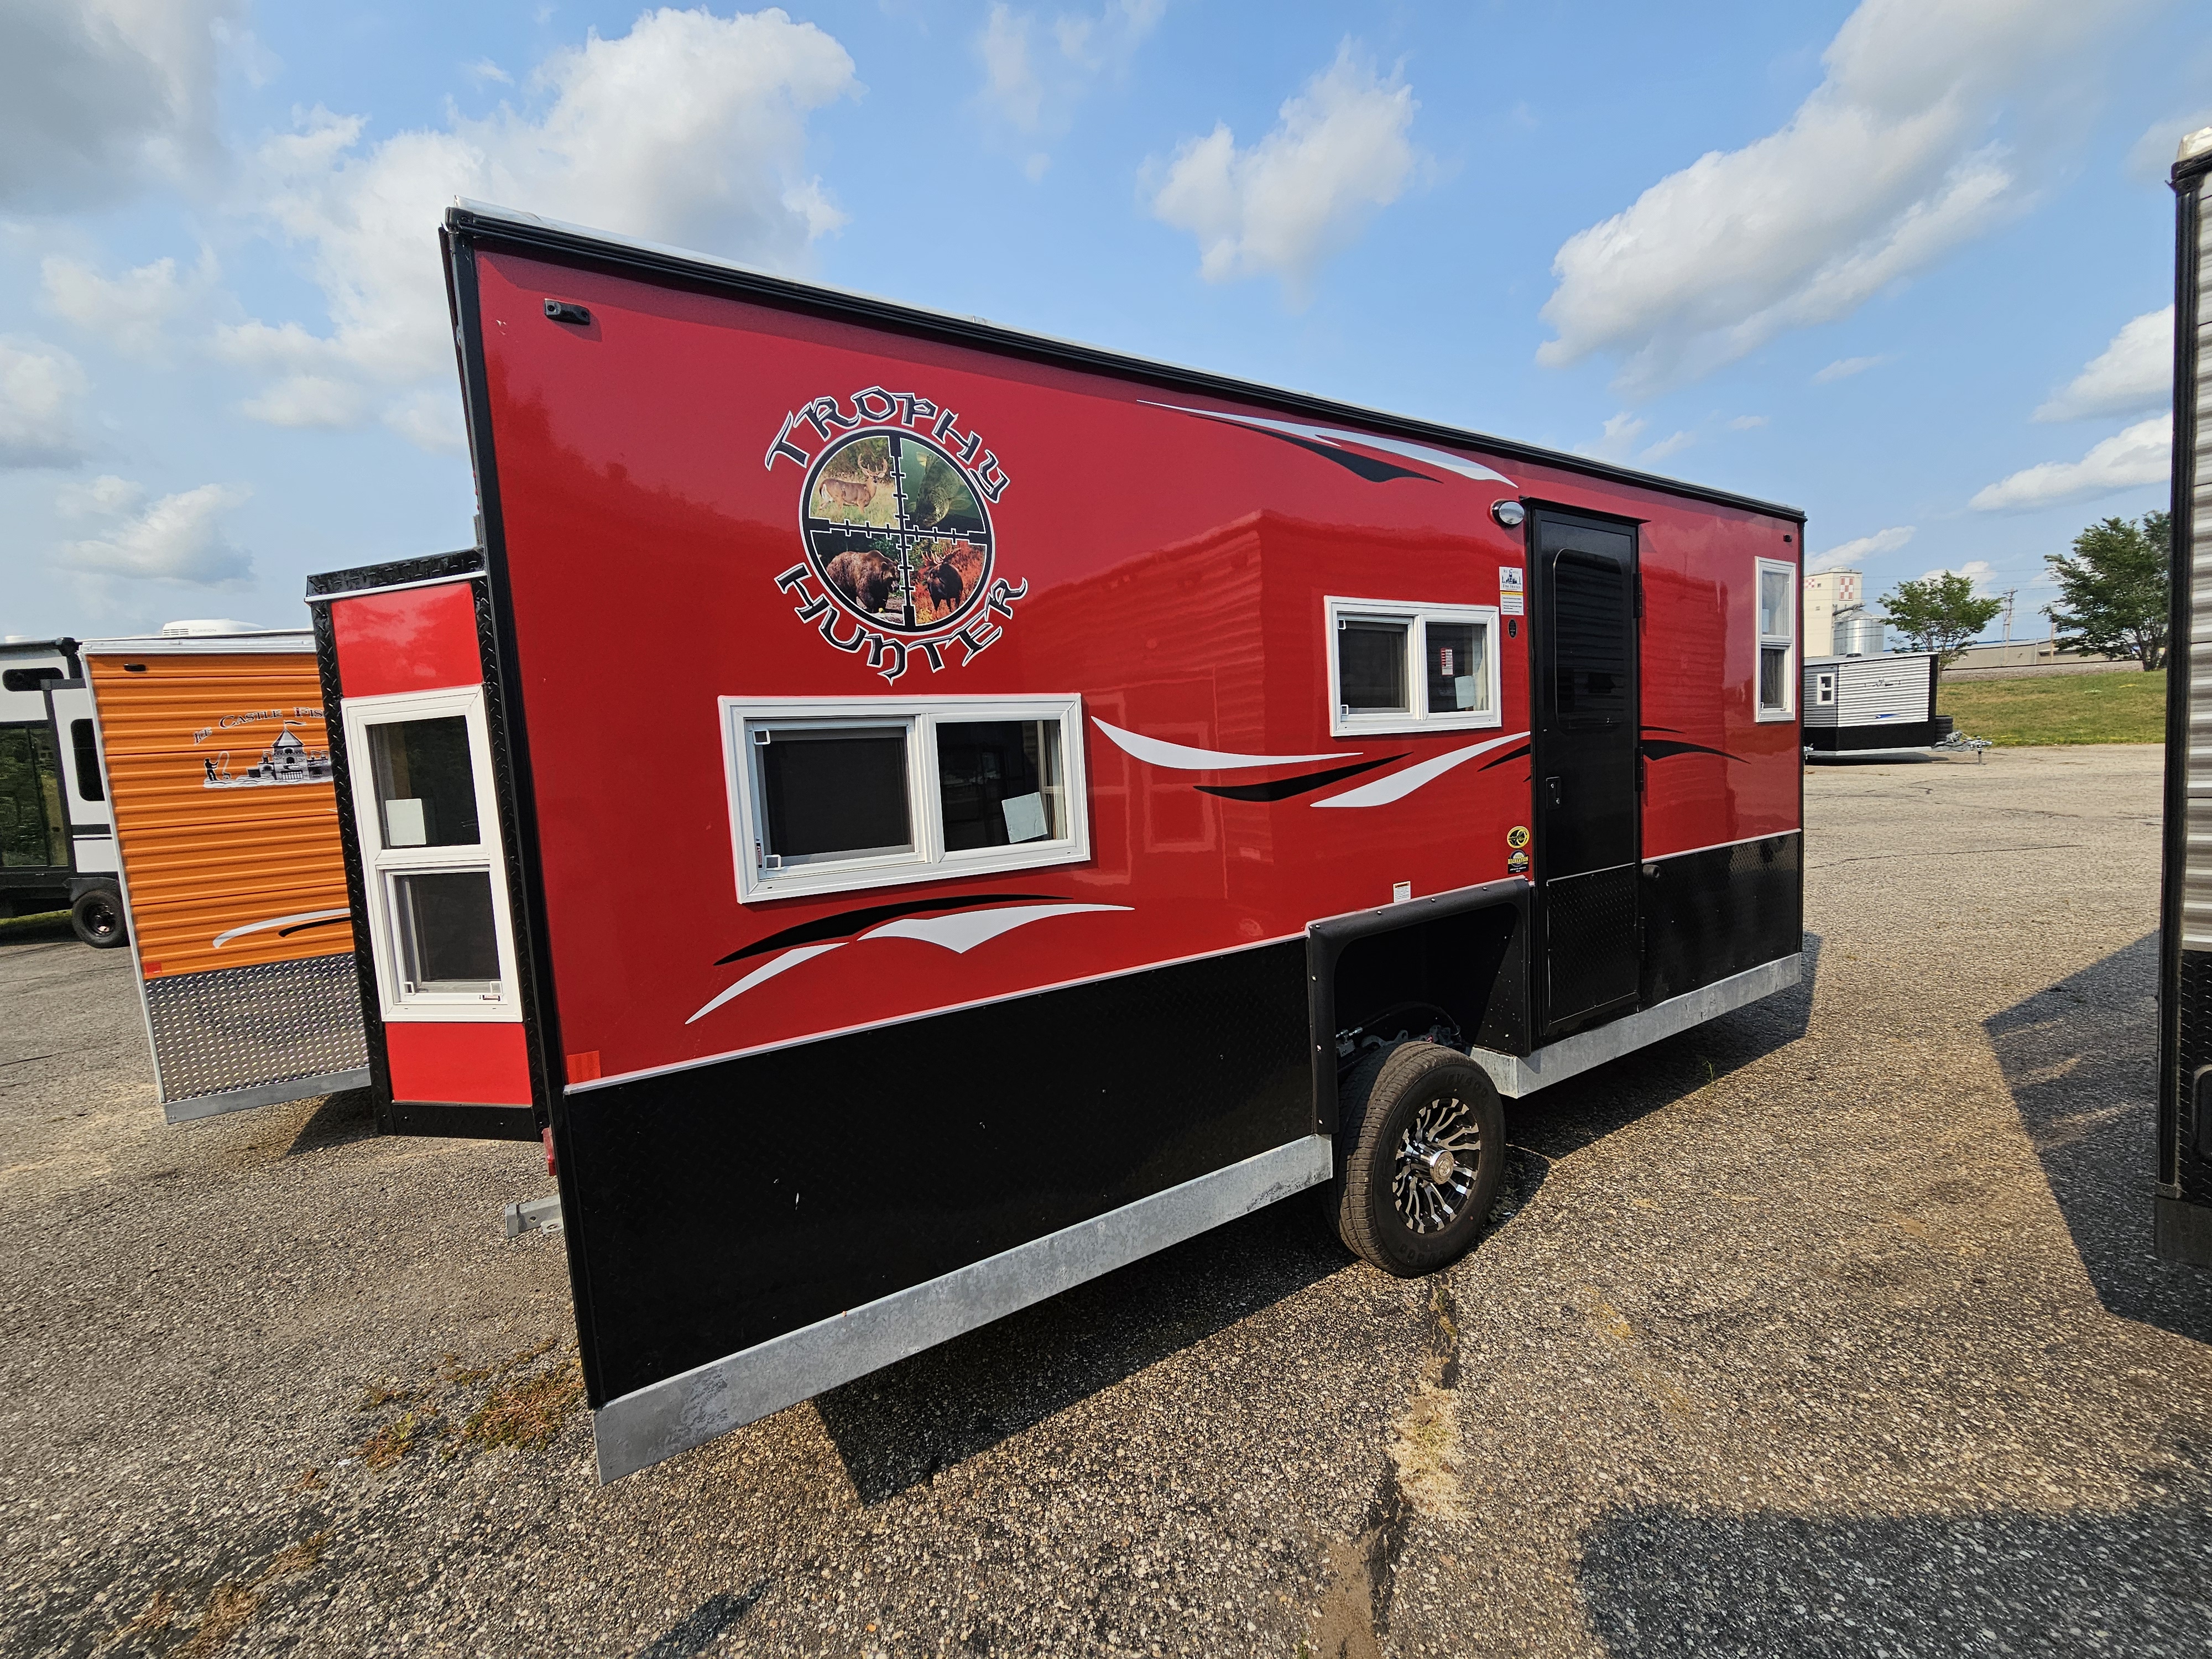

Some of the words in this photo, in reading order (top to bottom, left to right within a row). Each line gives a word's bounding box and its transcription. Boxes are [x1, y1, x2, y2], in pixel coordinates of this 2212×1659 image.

[765, 385, 1010, 504] TROPHY
[774, 562, 1029, 686] HUNTER
[193, 727, 213, 745] ICE
[218, 709, 283, 729] CASTLE
[293, 707, 325, 718] FIS
